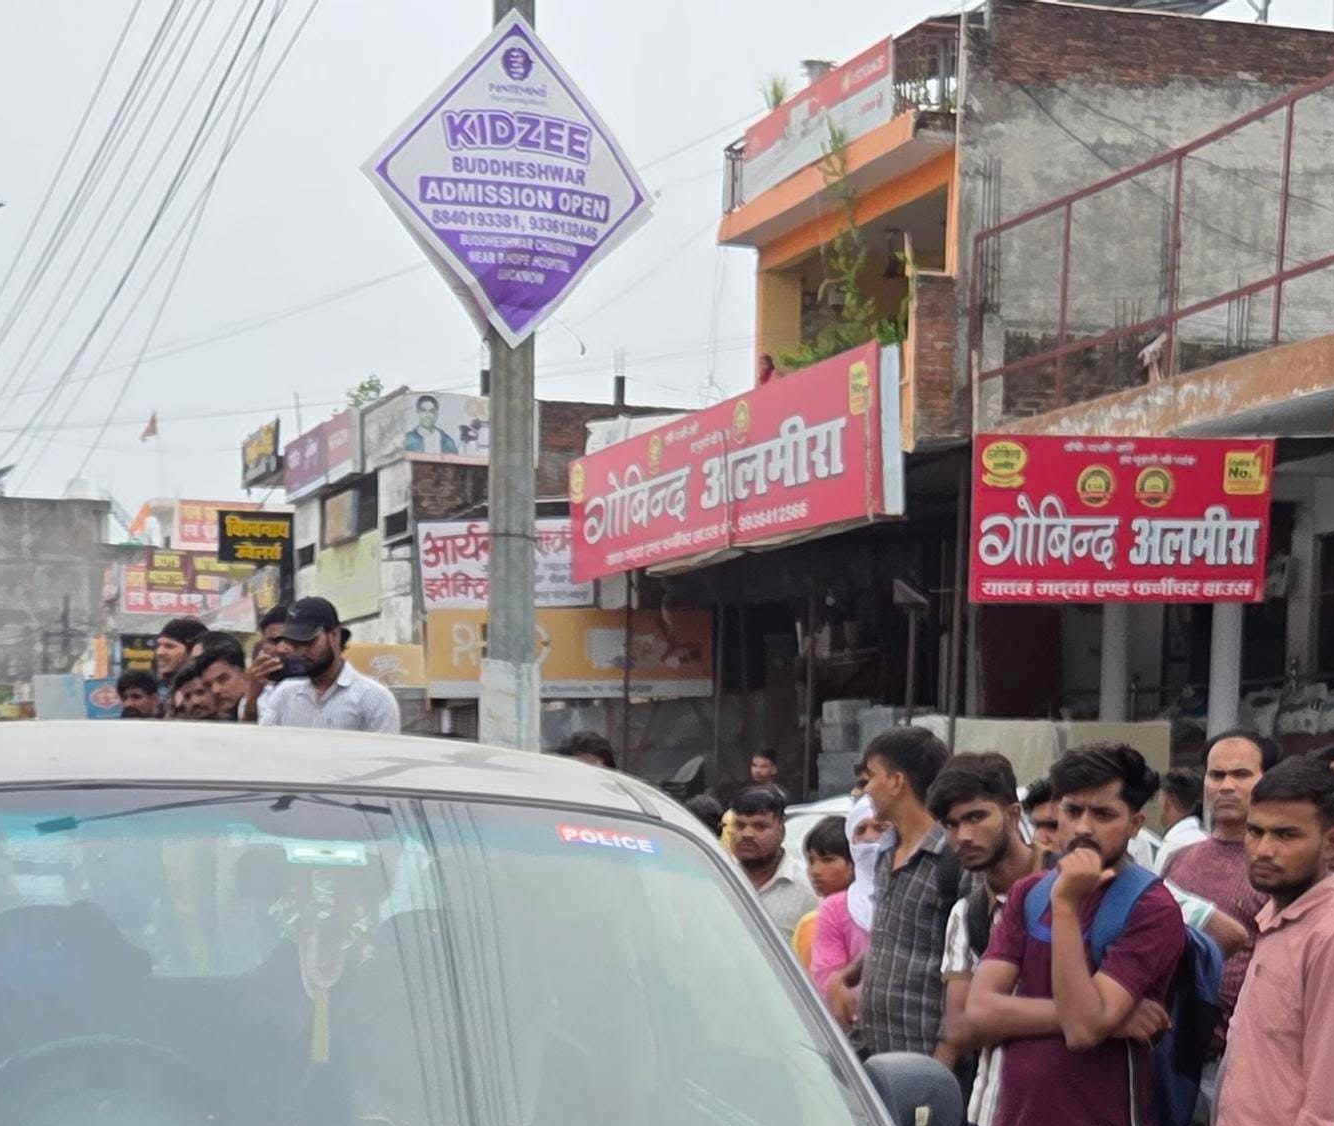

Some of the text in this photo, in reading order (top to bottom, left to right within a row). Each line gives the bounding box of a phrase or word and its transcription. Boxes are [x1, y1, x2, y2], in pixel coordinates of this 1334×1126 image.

[443, 110, 592, 163] KIDZEE
[452, 157, 586, 186] BUDDHESHWAR
[425, 181, 606, 221] ADMISSION OPEN
[583, 463, 691, 545] गोबिन्द
[701, 415, 848, 510] अलमीरा
[978, 492, 1260, 571] गोबिन्द अलमीरा
[560, 828, 655, 853] POLICE
